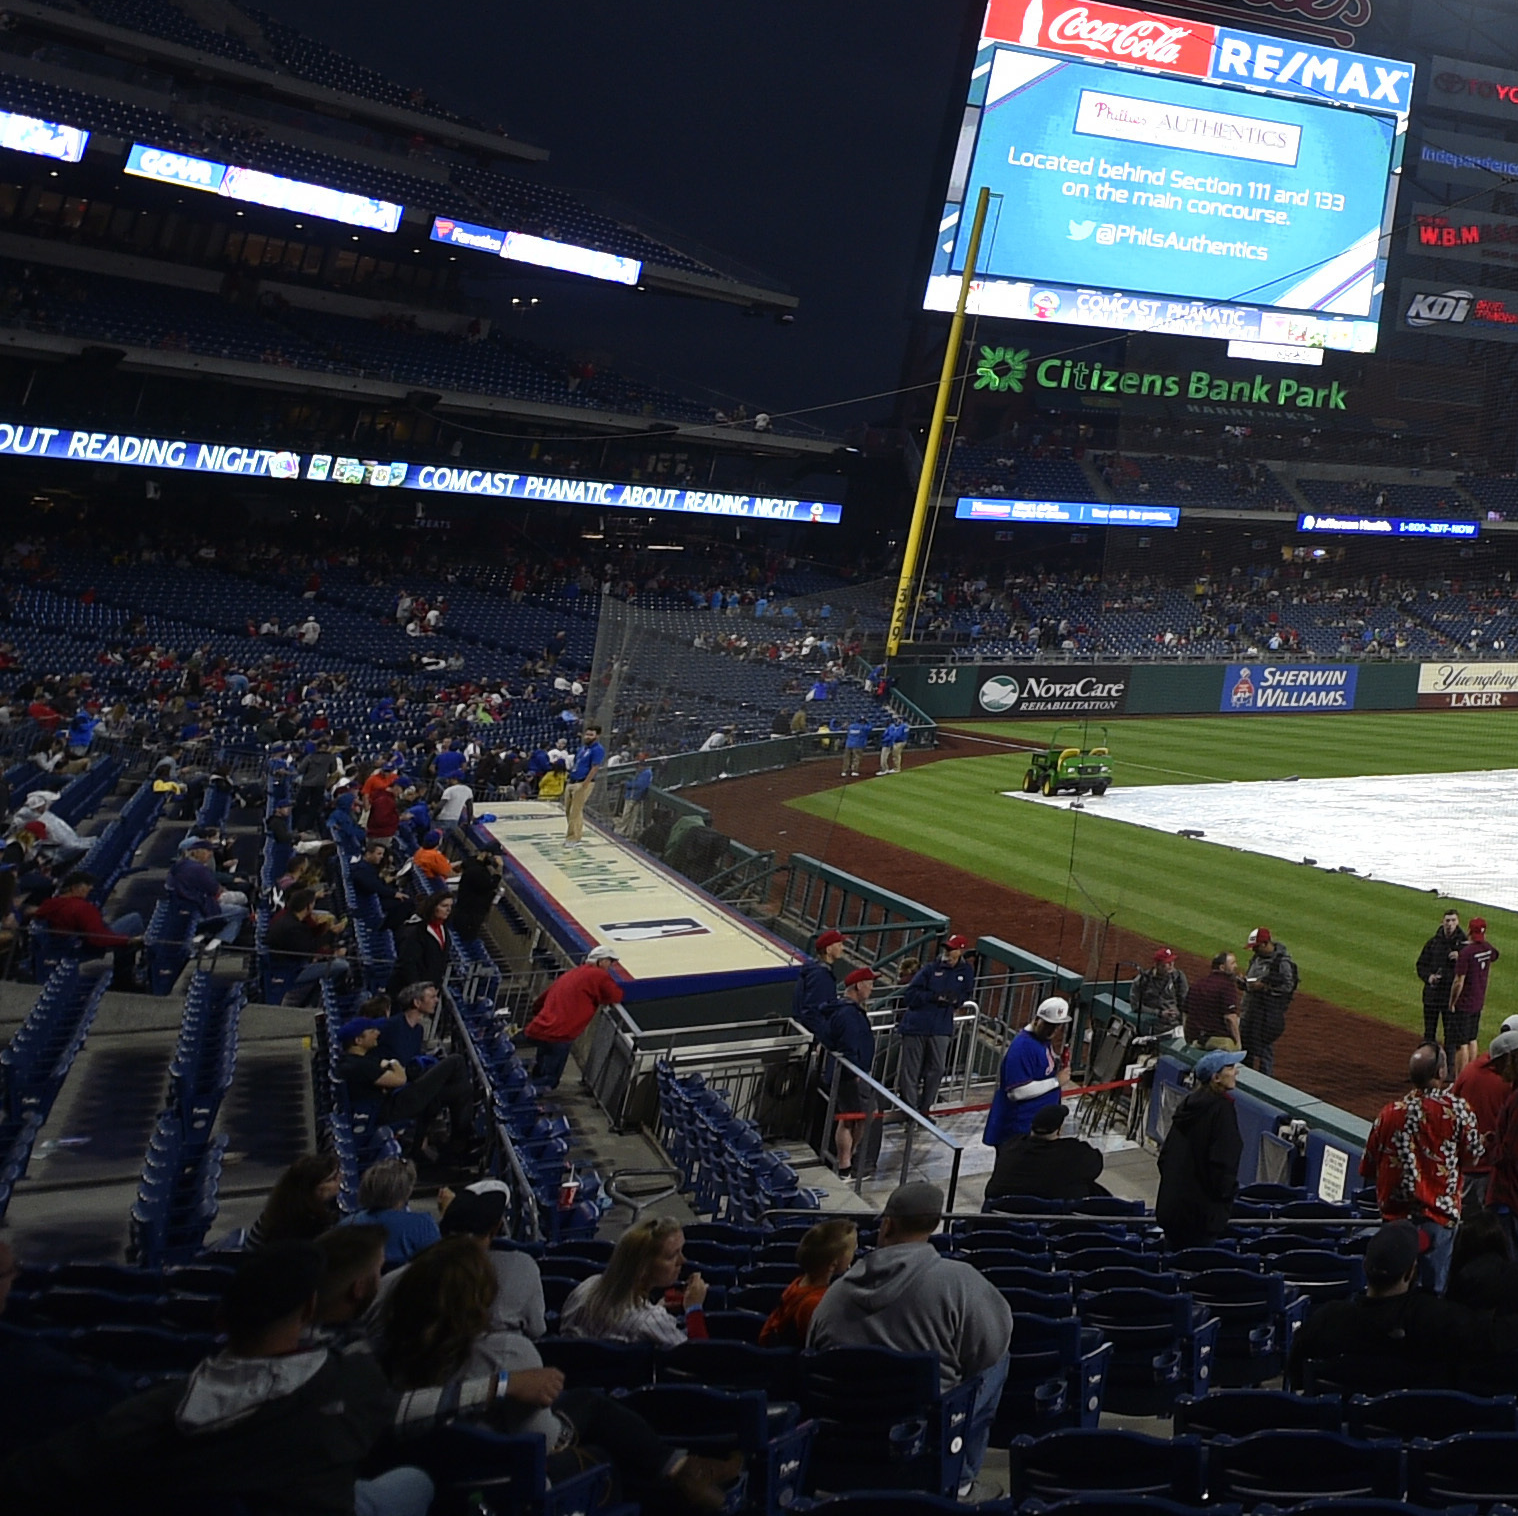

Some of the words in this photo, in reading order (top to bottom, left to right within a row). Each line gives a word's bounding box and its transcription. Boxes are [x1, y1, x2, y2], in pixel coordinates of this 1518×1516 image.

[1048, 7, 1193, 65] Coca-Cola
[1218, 37, 1402, 104] RE/MAX
[1095, 101, 1147, 127] Phillies
[1157, 113, 1288, 150] AUTHENTICS
[140, 149, 213, 185] GOYA
[1007, 146, 1094, 176] Located
[1099, 158, 1165, 185] behind
[1170, 170, 1243, 197] Section
[1247, 182, 1271, 202] 111
[1274, 186, 1310, 206] and
[1314, 191, 1346, 212] 133
[1062, 181, 1091, 197] on
[1095, 182, 1128, 202] the
[1132, 190, 1183, 210] main
[1187, 198, 1291, 226] concourse.
[452, 226, 502, 252] Fanatics
[1095, 223, 1269, 262] @PhilsAuthentics
[1077, 294, 1161, 319] COMCAST
[1166, 303, 1246, 327] PHANATIC
[1407, 293, 1472, 323] KDI
[1036, 358, 1180, 398] Citizens
[1188, 371, 1270, 405] Bank
[1278, 378, 1348, 411] Park
[1186, 404, 1252, 419] HARRY
[67, 431, 187, 467] READING
[197, 443, 272, 474] NIGHT
[418, 465, 519, 495] COMCAST
[524, 475, 615, 505] PHANATIC
[619, 484, 680, 509] ABOUT
[683, 490, 749, 515] READING
[753, 498, 800, 519] NIGHT
[927, 668, 958, 684] 334
[1020, 677, 1124, 699] NovaCare
[1260, 668, 1347, 687] SHERWIN
[1019, 701, 1119, 712] REHABILITATION
[1256, 688, 1344, 708] WILLIAMS
[1450, 693, 1502, 707] LAGER
